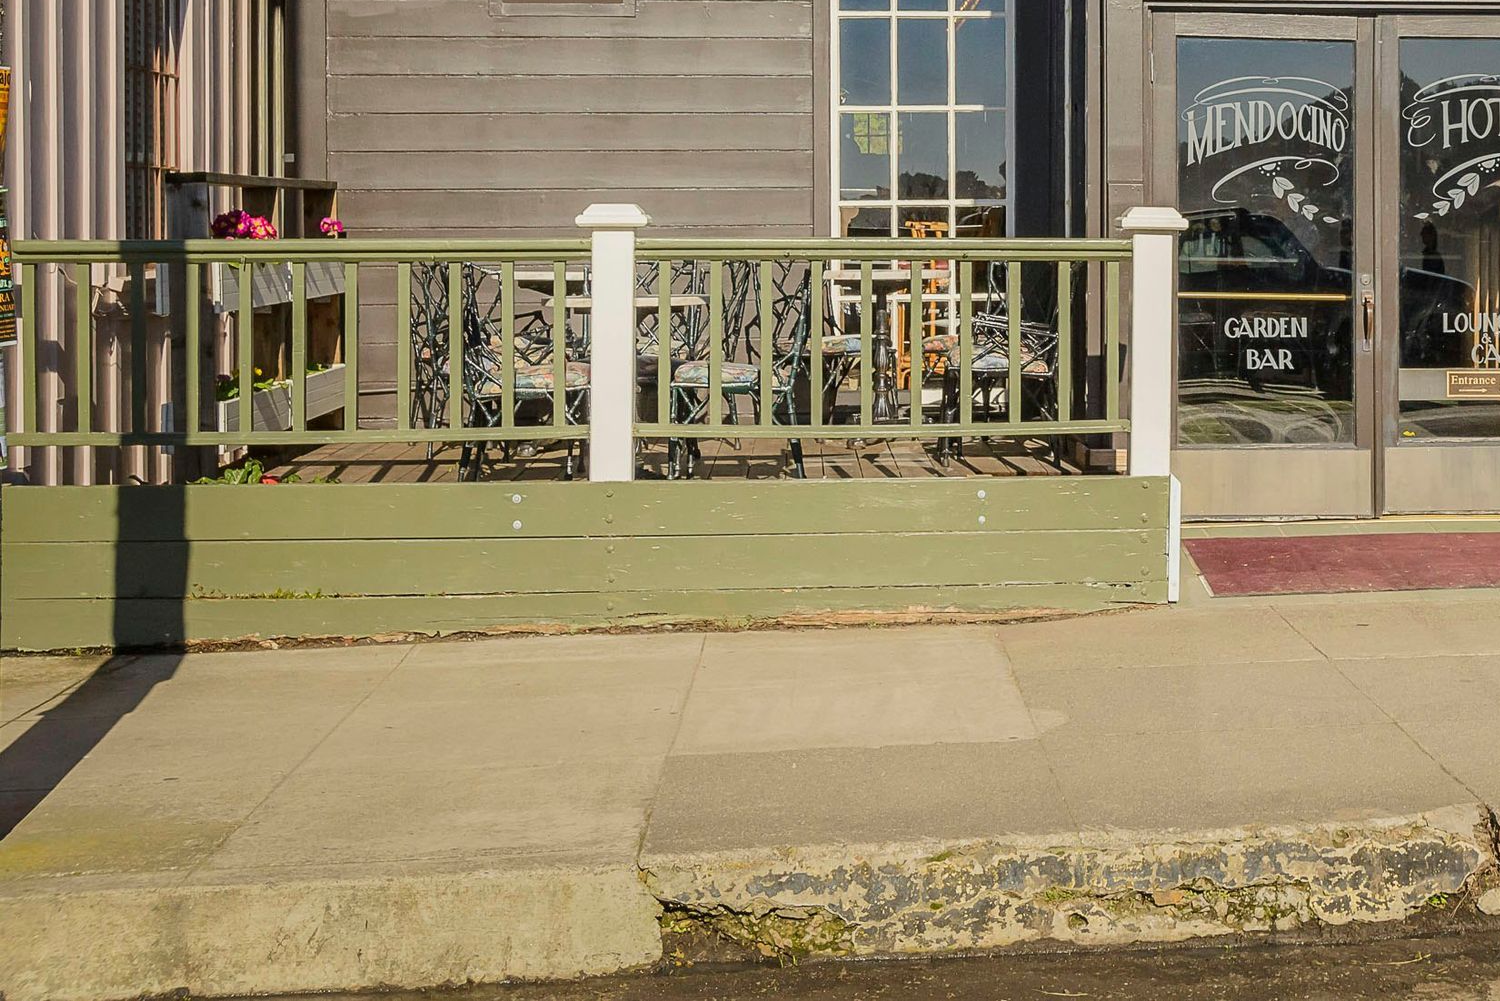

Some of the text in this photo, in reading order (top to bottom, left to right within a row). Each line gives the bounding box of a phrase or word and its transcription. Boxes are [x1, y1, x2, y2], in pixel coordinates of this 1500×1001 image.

[1186, 100, 1346, 166] MENDOCINO
[1223, 317, 1308, 338] GARDEN
[1481, 333, 1492, 344] &
[1246, 348, 1295, 370] BAR
[1450, 375, 1497, 385] Entrance
